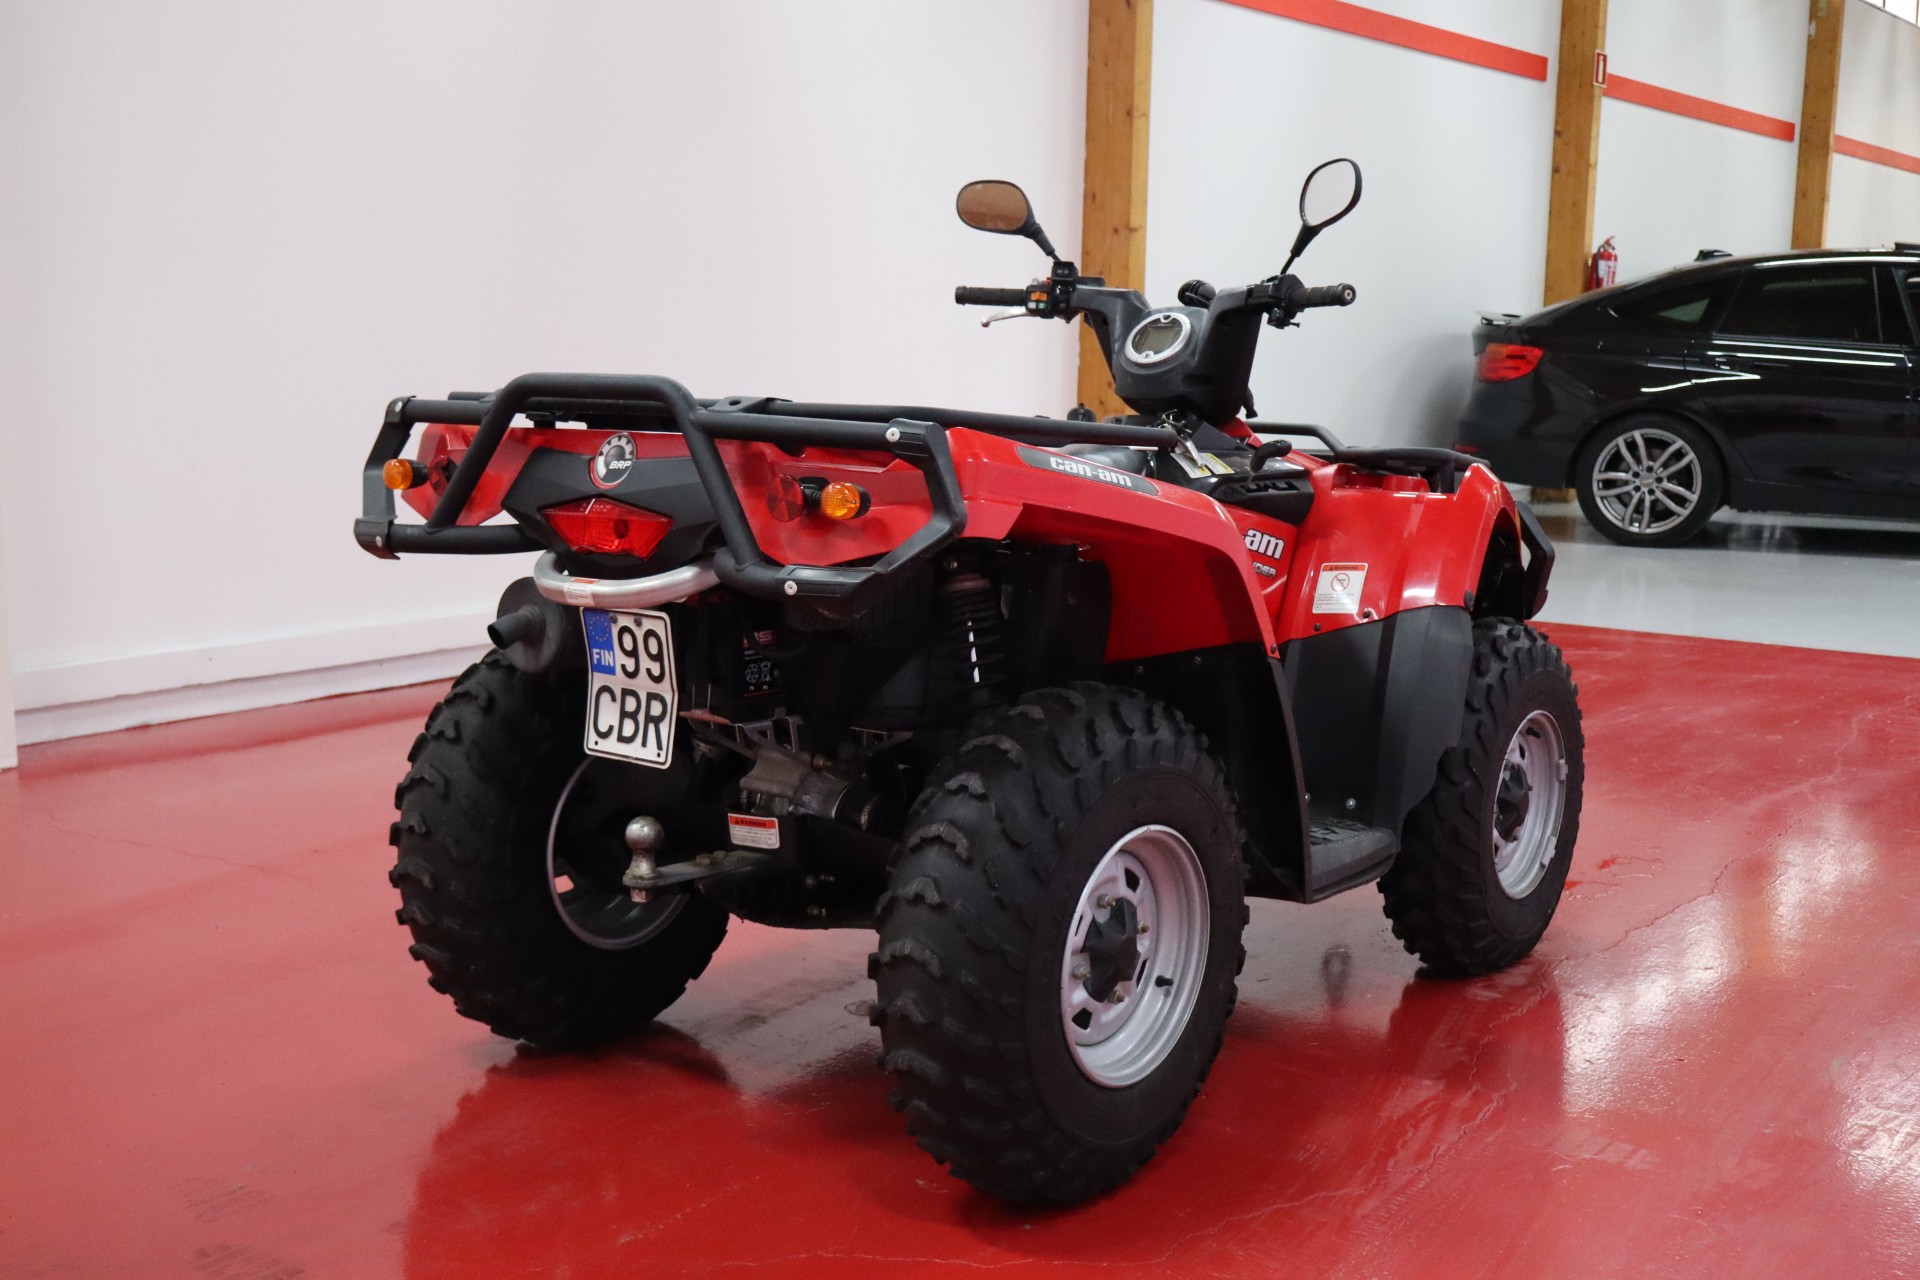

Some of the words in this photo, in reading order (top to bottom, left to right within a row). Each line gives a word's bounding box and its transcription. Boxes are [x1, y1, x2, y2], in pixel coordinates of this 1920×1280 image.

[609, 460, 632, 469] BRP
[1050, 457, 1133, 487] can-am
[1243, 529, 1285, 560] am
[592, 648, 614, 667] FIN
[617, 625, 665, 684] 99
[593, 684, 668, 751] CBR
